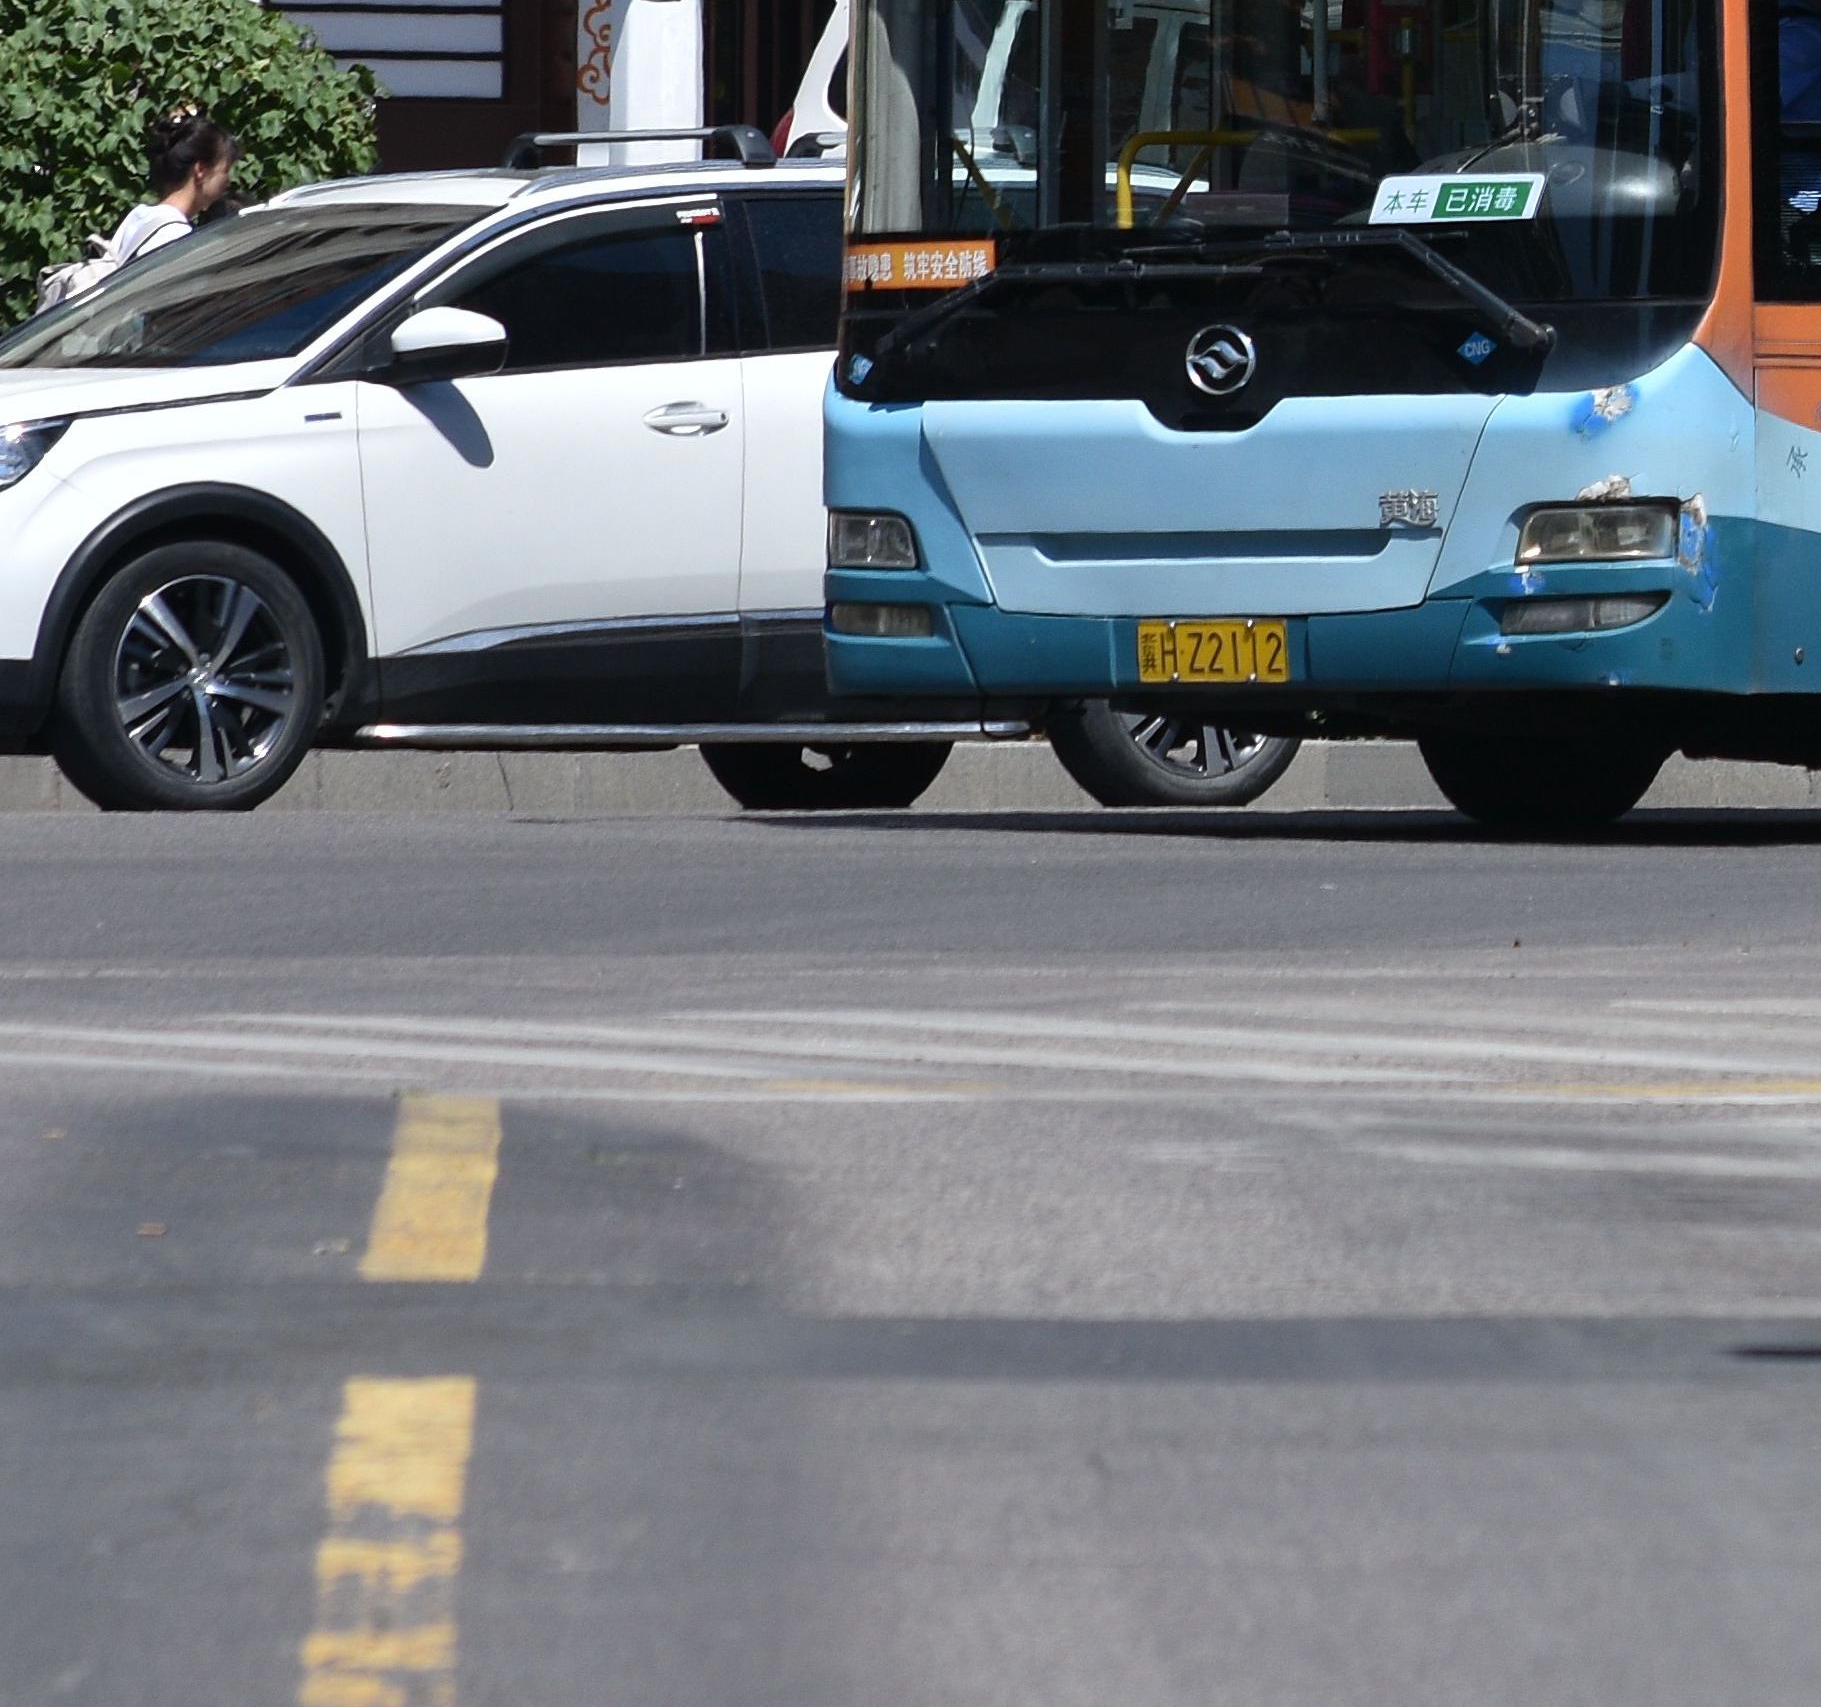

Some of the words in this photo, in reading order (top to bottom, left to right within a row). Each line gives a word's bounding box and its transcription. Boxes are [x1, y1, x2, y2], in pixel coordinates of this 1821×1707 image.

[1382, 189, 1430, 215] 本车
[1444, 185, 1519, 213] 已消毒
[1464, 339, 1490, 358] CNG
[1378, 489, 1440, 529] 黄海
